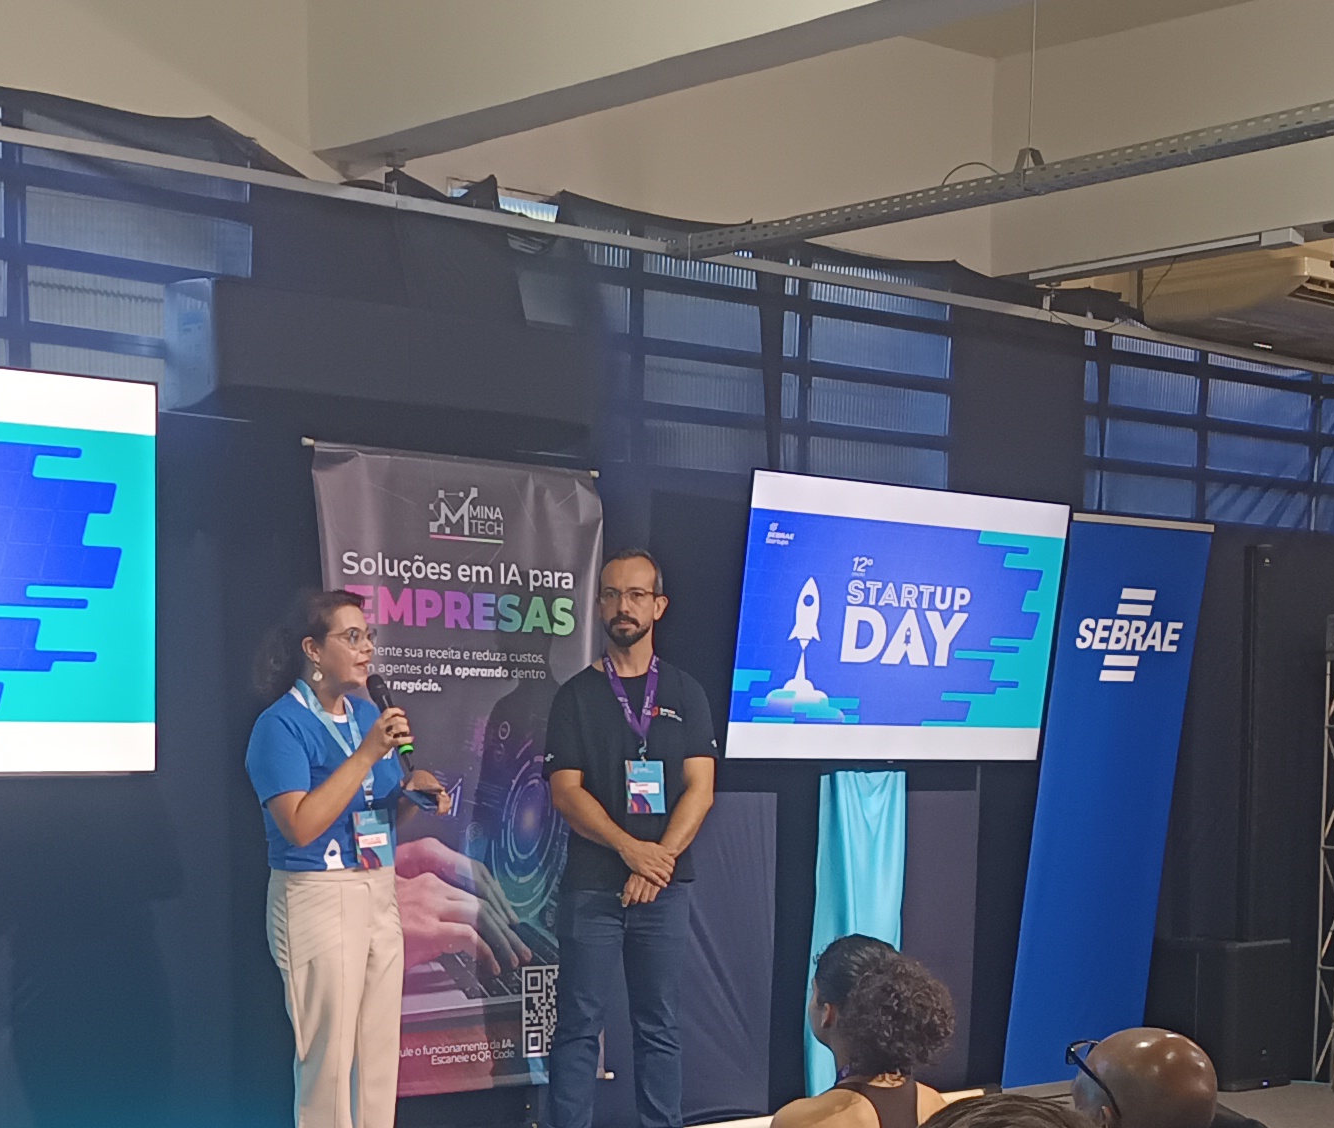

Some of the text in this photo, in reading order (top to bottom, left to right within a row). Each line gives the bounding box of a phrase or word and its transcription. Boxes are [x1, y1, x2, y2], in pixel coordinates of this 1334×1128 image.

[469, 505, 504, 521] MINA
[470, 520, 504, 536] TECH
[342, 552, 575, 592] Soluções em IA para
[846, 579, 972, 611] STARTUP
[840, 605, 969, 667] DAY
[1075, 617, 1184, 653] SEBRAE
[404, 648, 423, 659] sua
[425, 648, 461, 661] receita
[463, 652, 471, 660] e
[472, 650, 508, 662] reduza
[509, 652, 546, 665] custos,
[378, 663, 422, 677] agentes
[423, 664, 438, 674] de
[439, 664, 453, 676] IA
[454, 666, 509, 680] operando
[510, 667, 547, 680] dentro
[393, 679, 442, 694] negócio.
[423, 1041, 489, 1056] funcionamento
[490, 1040, 501, 1050] da
[431, 1053, 469, 1066] Escaneie
[478, 1051, 491, 1062] QR
[493, 1049, 516, 1060] Code
